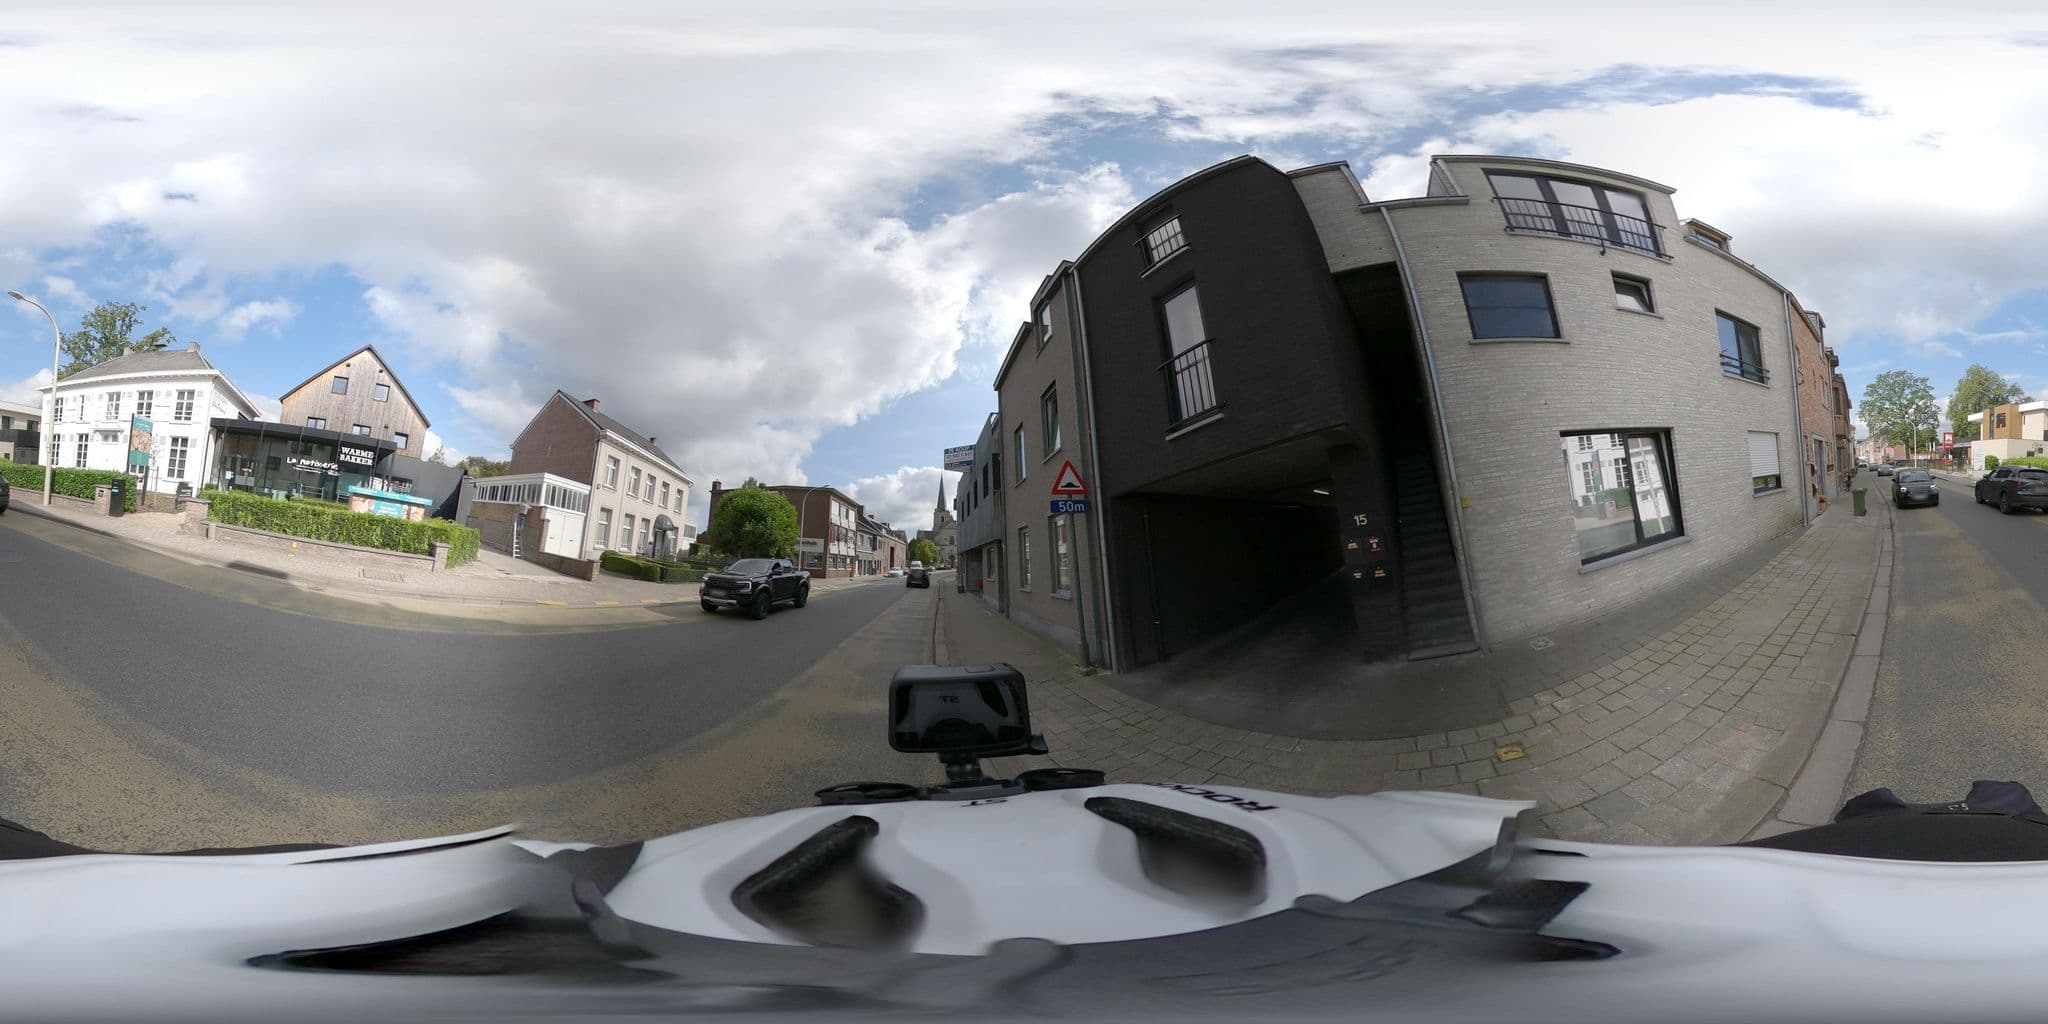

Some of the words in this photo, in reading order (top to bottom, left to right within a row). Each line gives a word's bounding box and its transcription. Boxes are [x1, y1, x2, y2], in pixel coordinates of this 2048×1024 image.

[341, 446, 374, 458] WARME
[340, 454, 373, 466] BAKKER
[1058, 501, 1085, 512] 50m
[1354, 513, 1368, 526] 15
